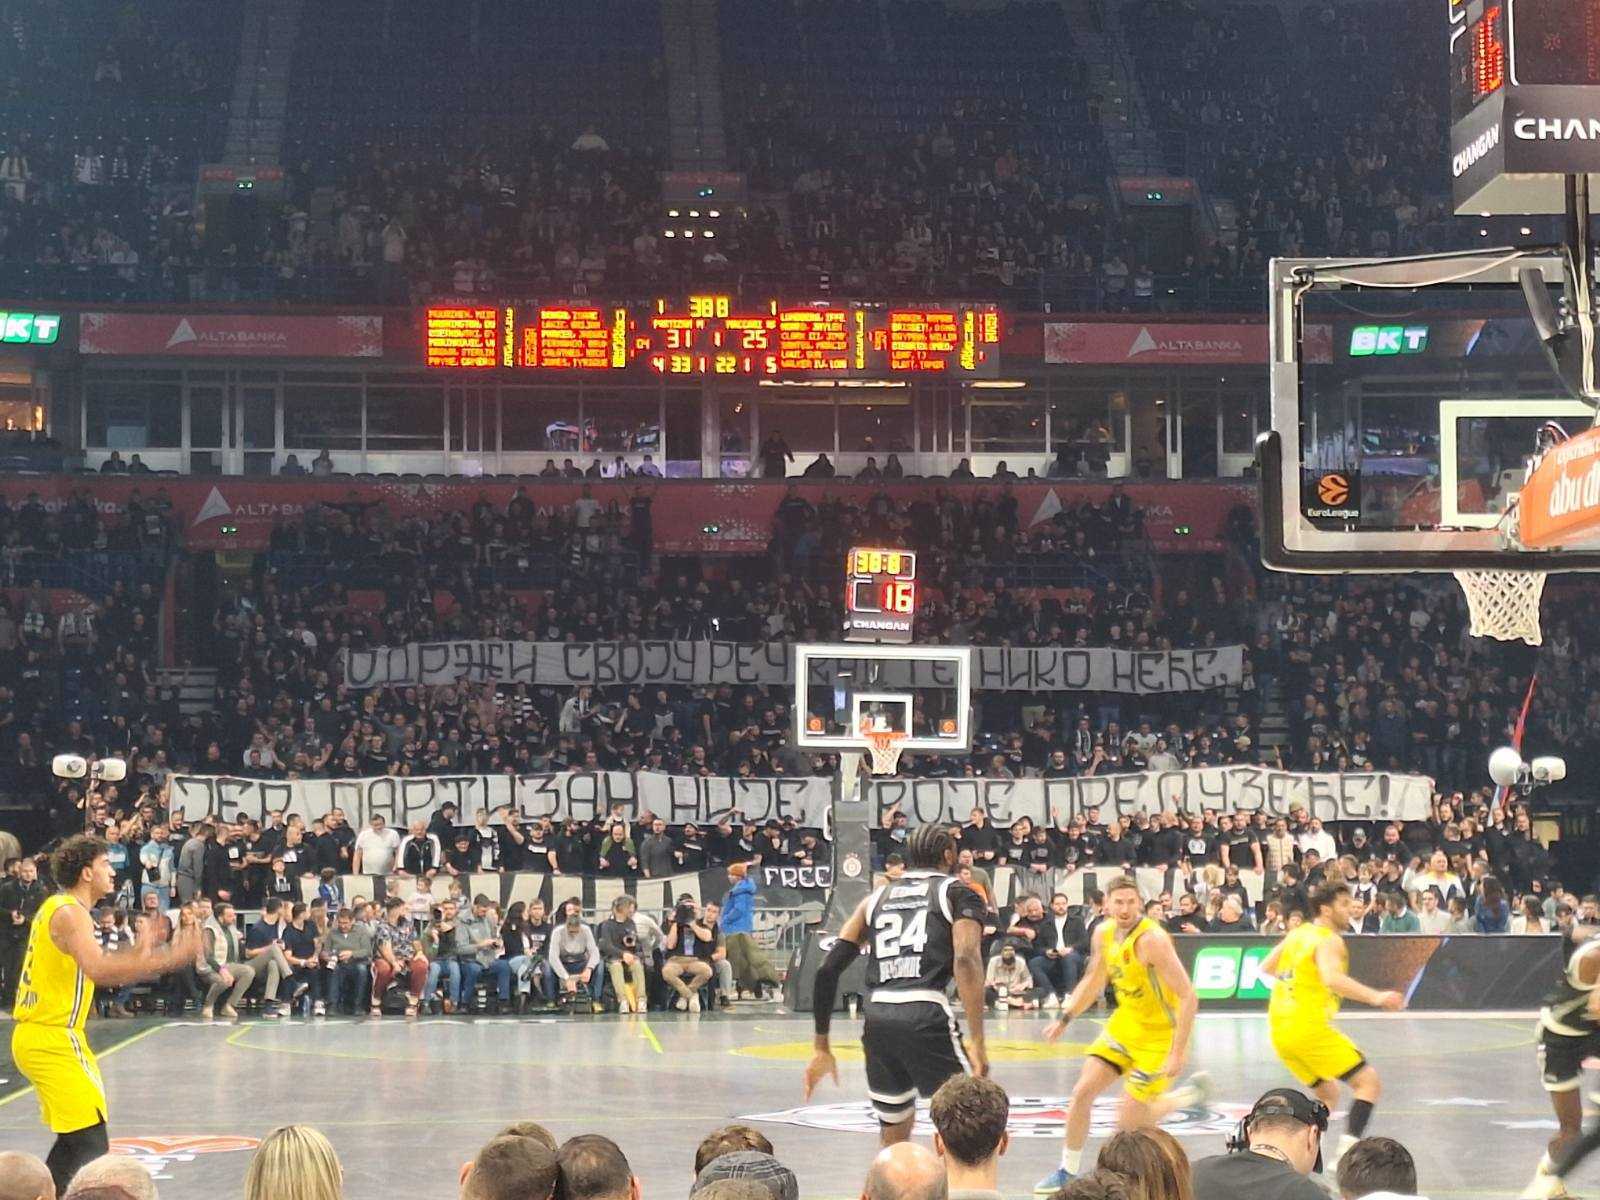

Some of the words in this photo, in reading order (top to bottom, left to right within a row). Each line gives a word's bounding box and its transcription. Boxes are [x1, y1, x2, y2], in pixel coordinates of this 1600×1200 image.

[1453, 124, 1499, 177] CHANGAN
[0, 319, 58, 339] KT
[199, 331, 288, 342] ALTABANKA
[666, 329, 692, 349] 31
[742, 329, 768, 349] 25
[1159, 340, 1242, 351] ALTABANKA
[1351, 329, 1427, 350] BKT
[886, 583, 912, 612] 16
[852, 620, 910, 630] CHANGAN
[979, 648, 1091, 689] НИКО
[764, 866, 832, 888] FREE
[875, 910, 928, 959] 24
